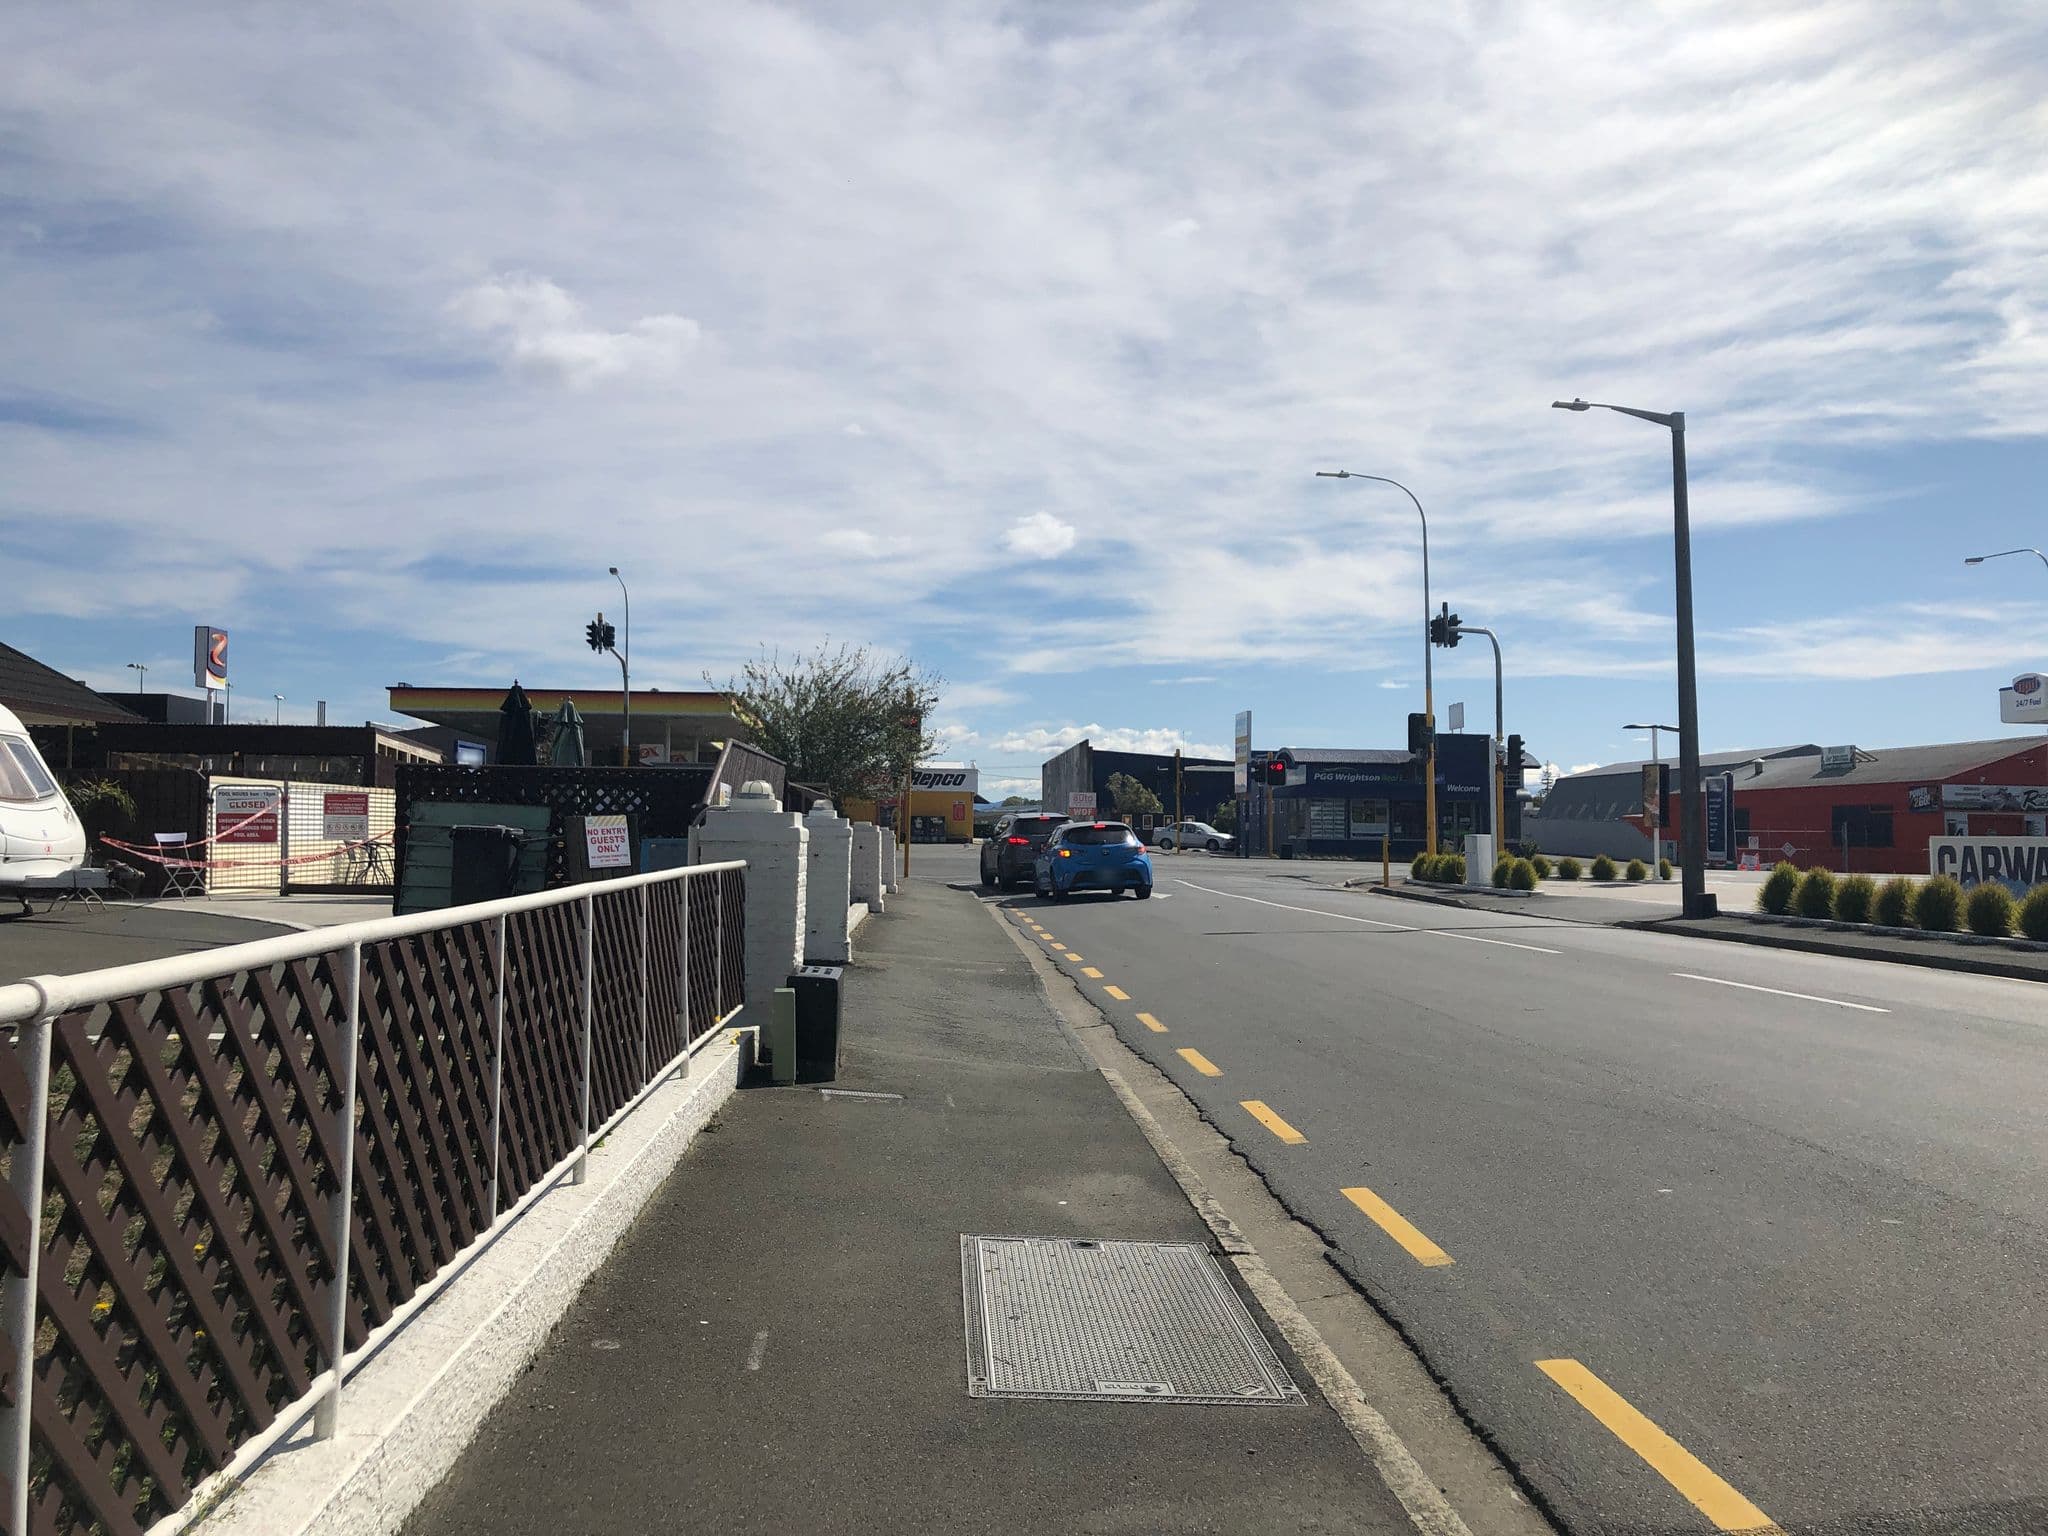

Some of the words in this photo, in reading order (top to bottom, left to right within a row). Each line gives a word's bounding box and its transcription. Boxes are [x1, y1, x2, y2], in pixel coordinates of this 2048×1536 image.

[911, 771, 967, 789] Repco
[1313, 772, 1334, 781] PGG
[1335, 772, 1381, 783] Wrightson
[1446, 784, 1481, 793] Welcome
[229, 801, 266, 809] CLOSED
[600, 827, 627, 835] ENTRY
[590, 835, 626, 845] GUESTS
[597, 845, 621, 853] ONLY
